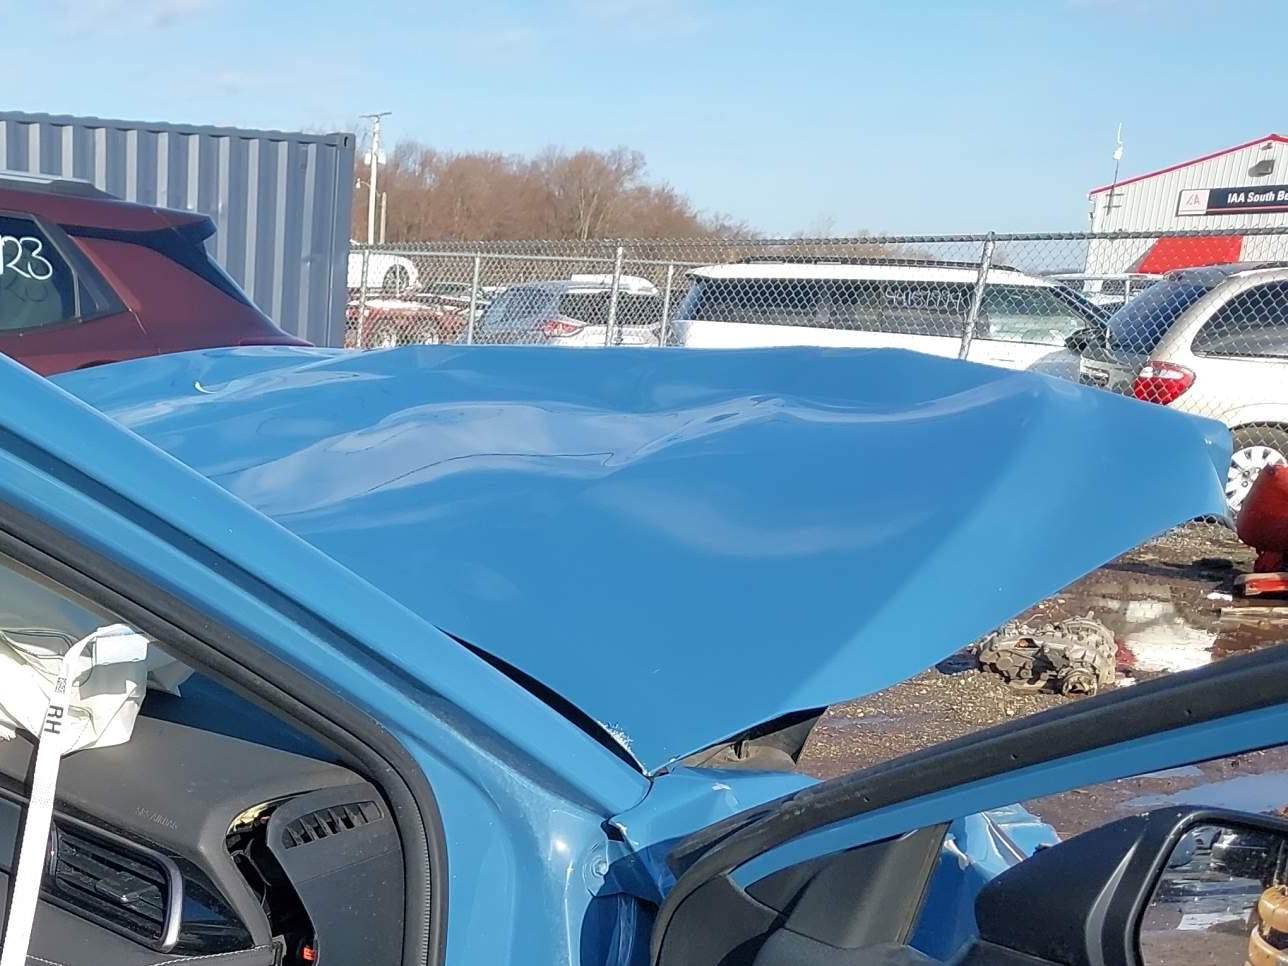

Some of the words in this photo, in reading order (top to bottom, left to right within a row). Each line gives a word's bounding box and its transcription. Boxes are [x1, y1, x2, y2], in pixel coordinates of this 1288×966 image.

[1227, 192, 1245, 203] IAA
[1247, 191, 1275, 203] South
[44, 705, 64, 734] RH
